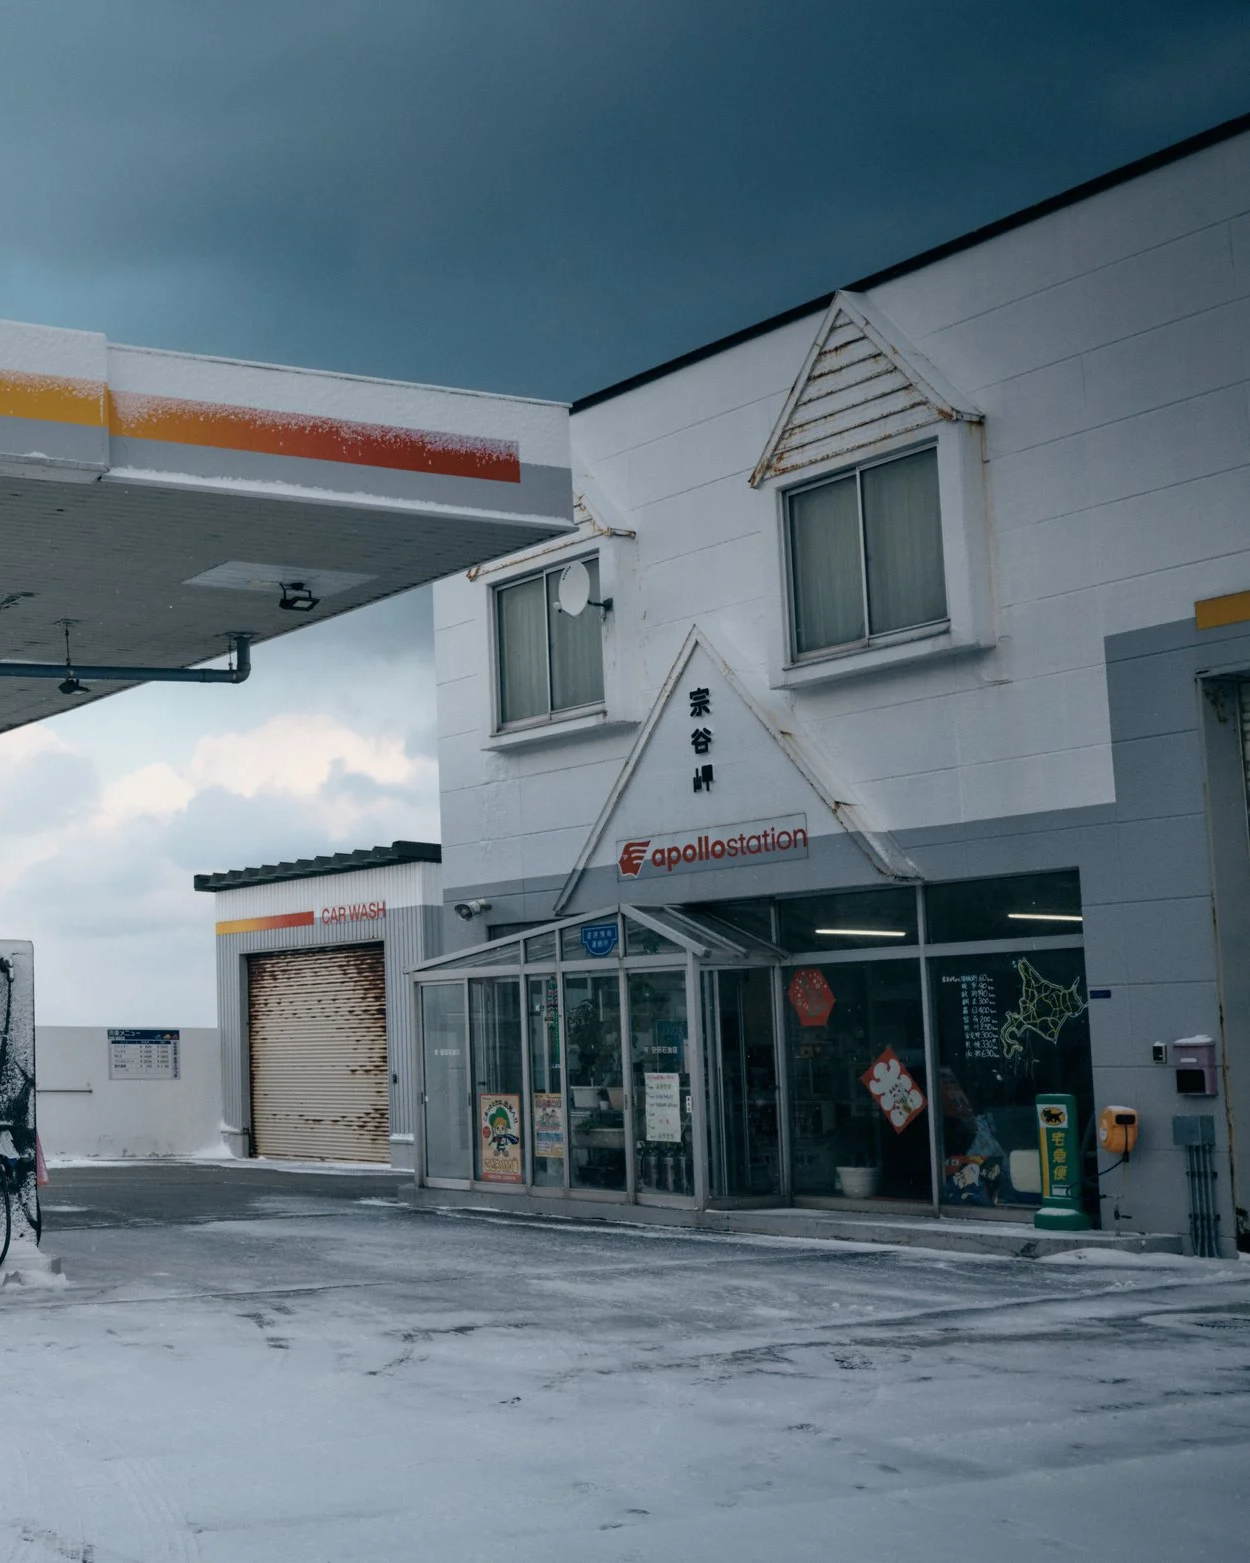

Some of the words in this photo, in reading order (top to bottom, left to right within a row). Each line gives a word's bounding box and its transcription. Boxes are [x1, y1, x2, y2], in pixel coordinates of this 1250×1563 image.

[689, 687, 713, 793] 宗谷岬
[651, 827, 807, 871] apollostation
[322, 906, 346, 925] CAR
[349, 900, 386, 921] WASH
[1051, 1131, 1068, 1180] 宅急便
